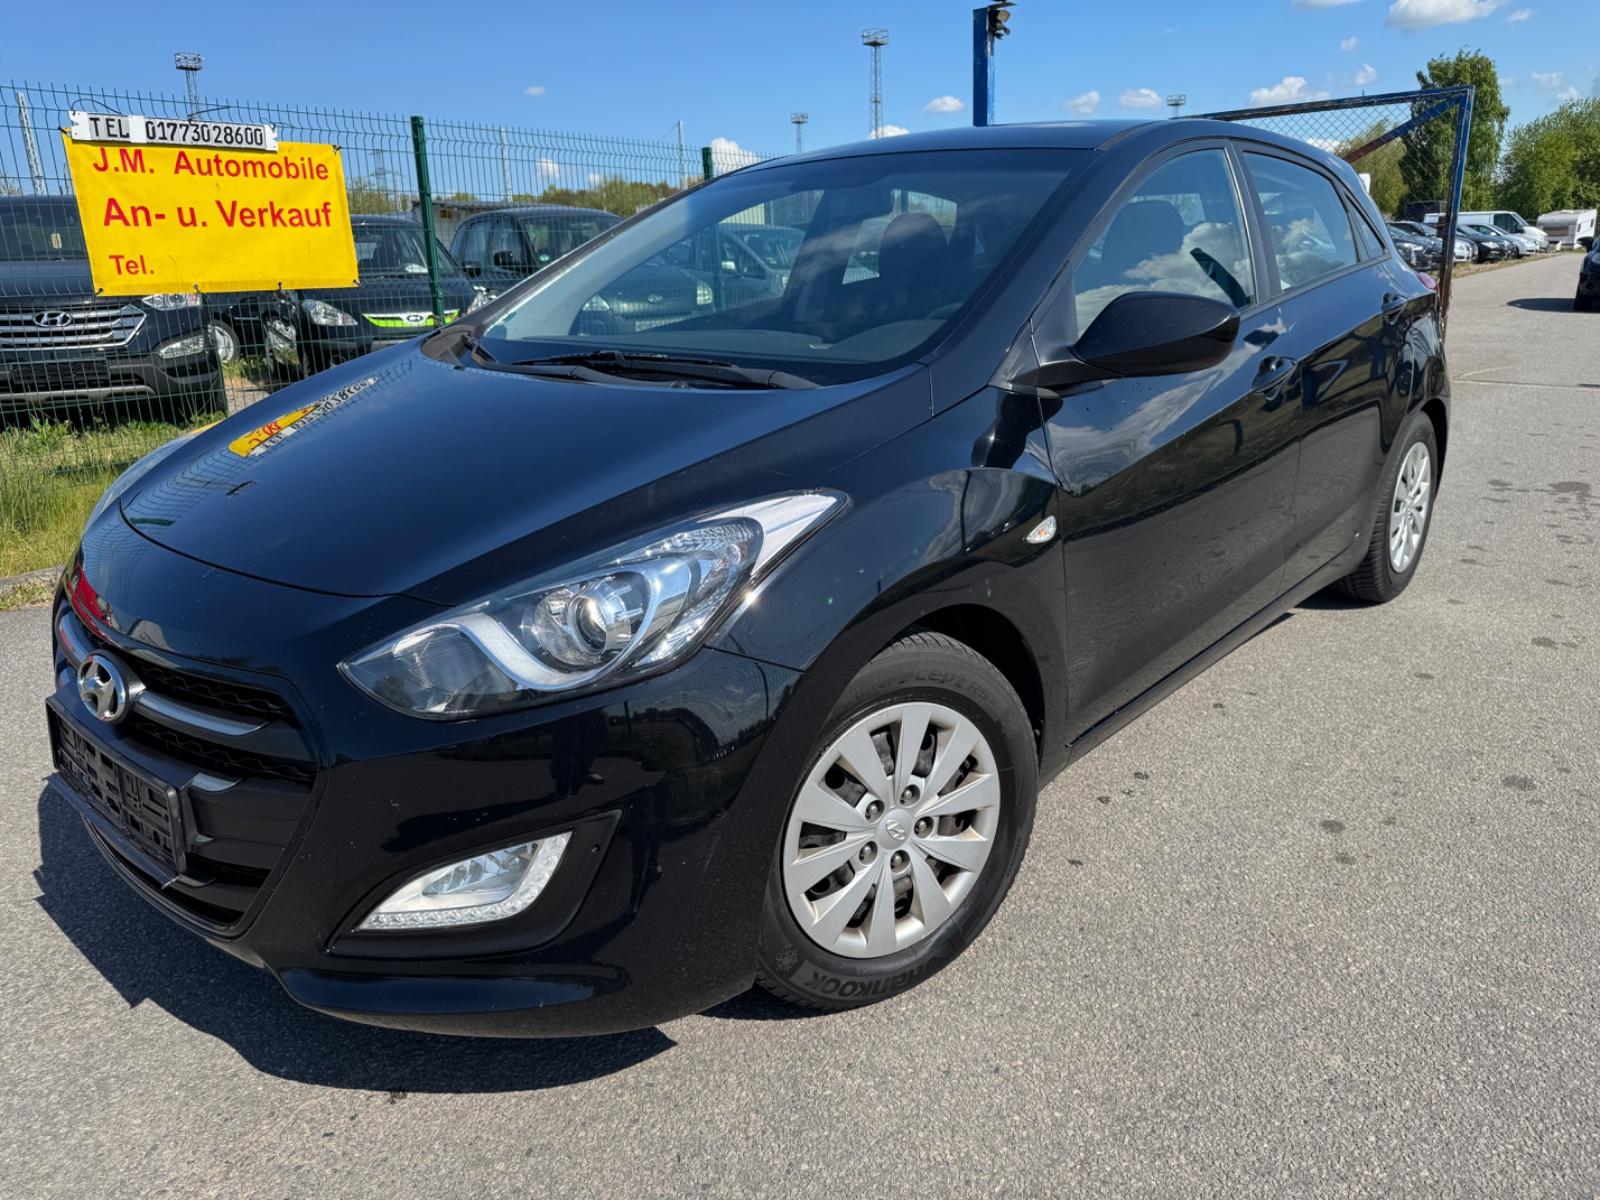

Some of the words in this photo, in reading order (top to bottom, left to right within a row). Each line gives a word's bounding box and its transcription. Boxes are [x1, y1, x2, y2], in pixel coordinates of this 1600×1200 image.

[88, 116, 130, 139] TEL
[144, 120, 264, 146] 01773028600
[93, 146, 155, 174] J.M.
[173, 150, 329, 180] Automobile
[103, 197, 166, 227] An-
[177, 206, 208, 228] u.
[215, 200, 332, 228] Verkauf
[108, 254, 155, 276] Tel.
